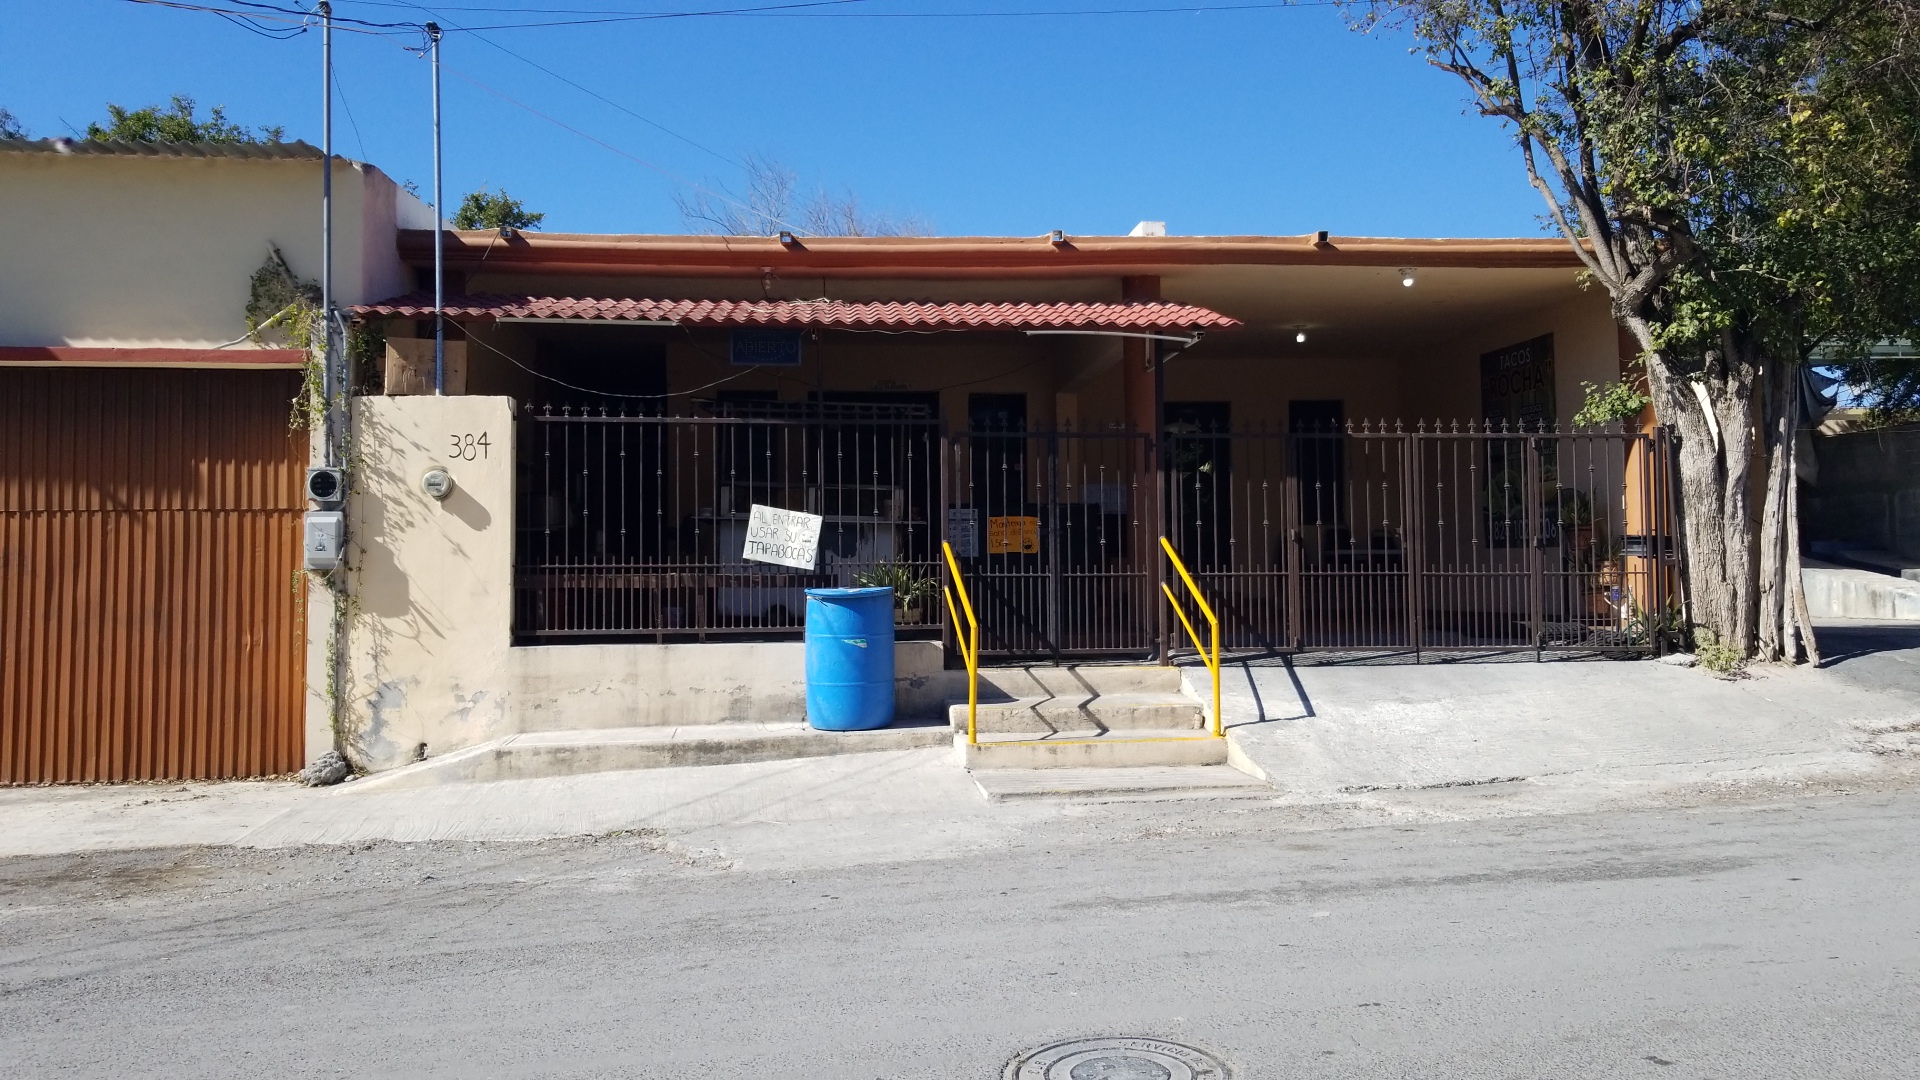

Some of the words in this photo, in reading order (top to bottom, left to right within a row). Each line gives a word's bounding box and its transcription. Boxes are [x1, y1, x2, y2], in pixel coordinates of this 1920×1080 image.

[735, 340, 797, 354] ABIERTO
[1499, 347, 1531, 370] TACOS
[448, 431, 492, 461] 384
[753, 510, 767, 524] AL
[750, 526, 779, 540] USAR
[785, 531, 797, 543] SU
[748, 540, 813, 563] TAPABOCAS
